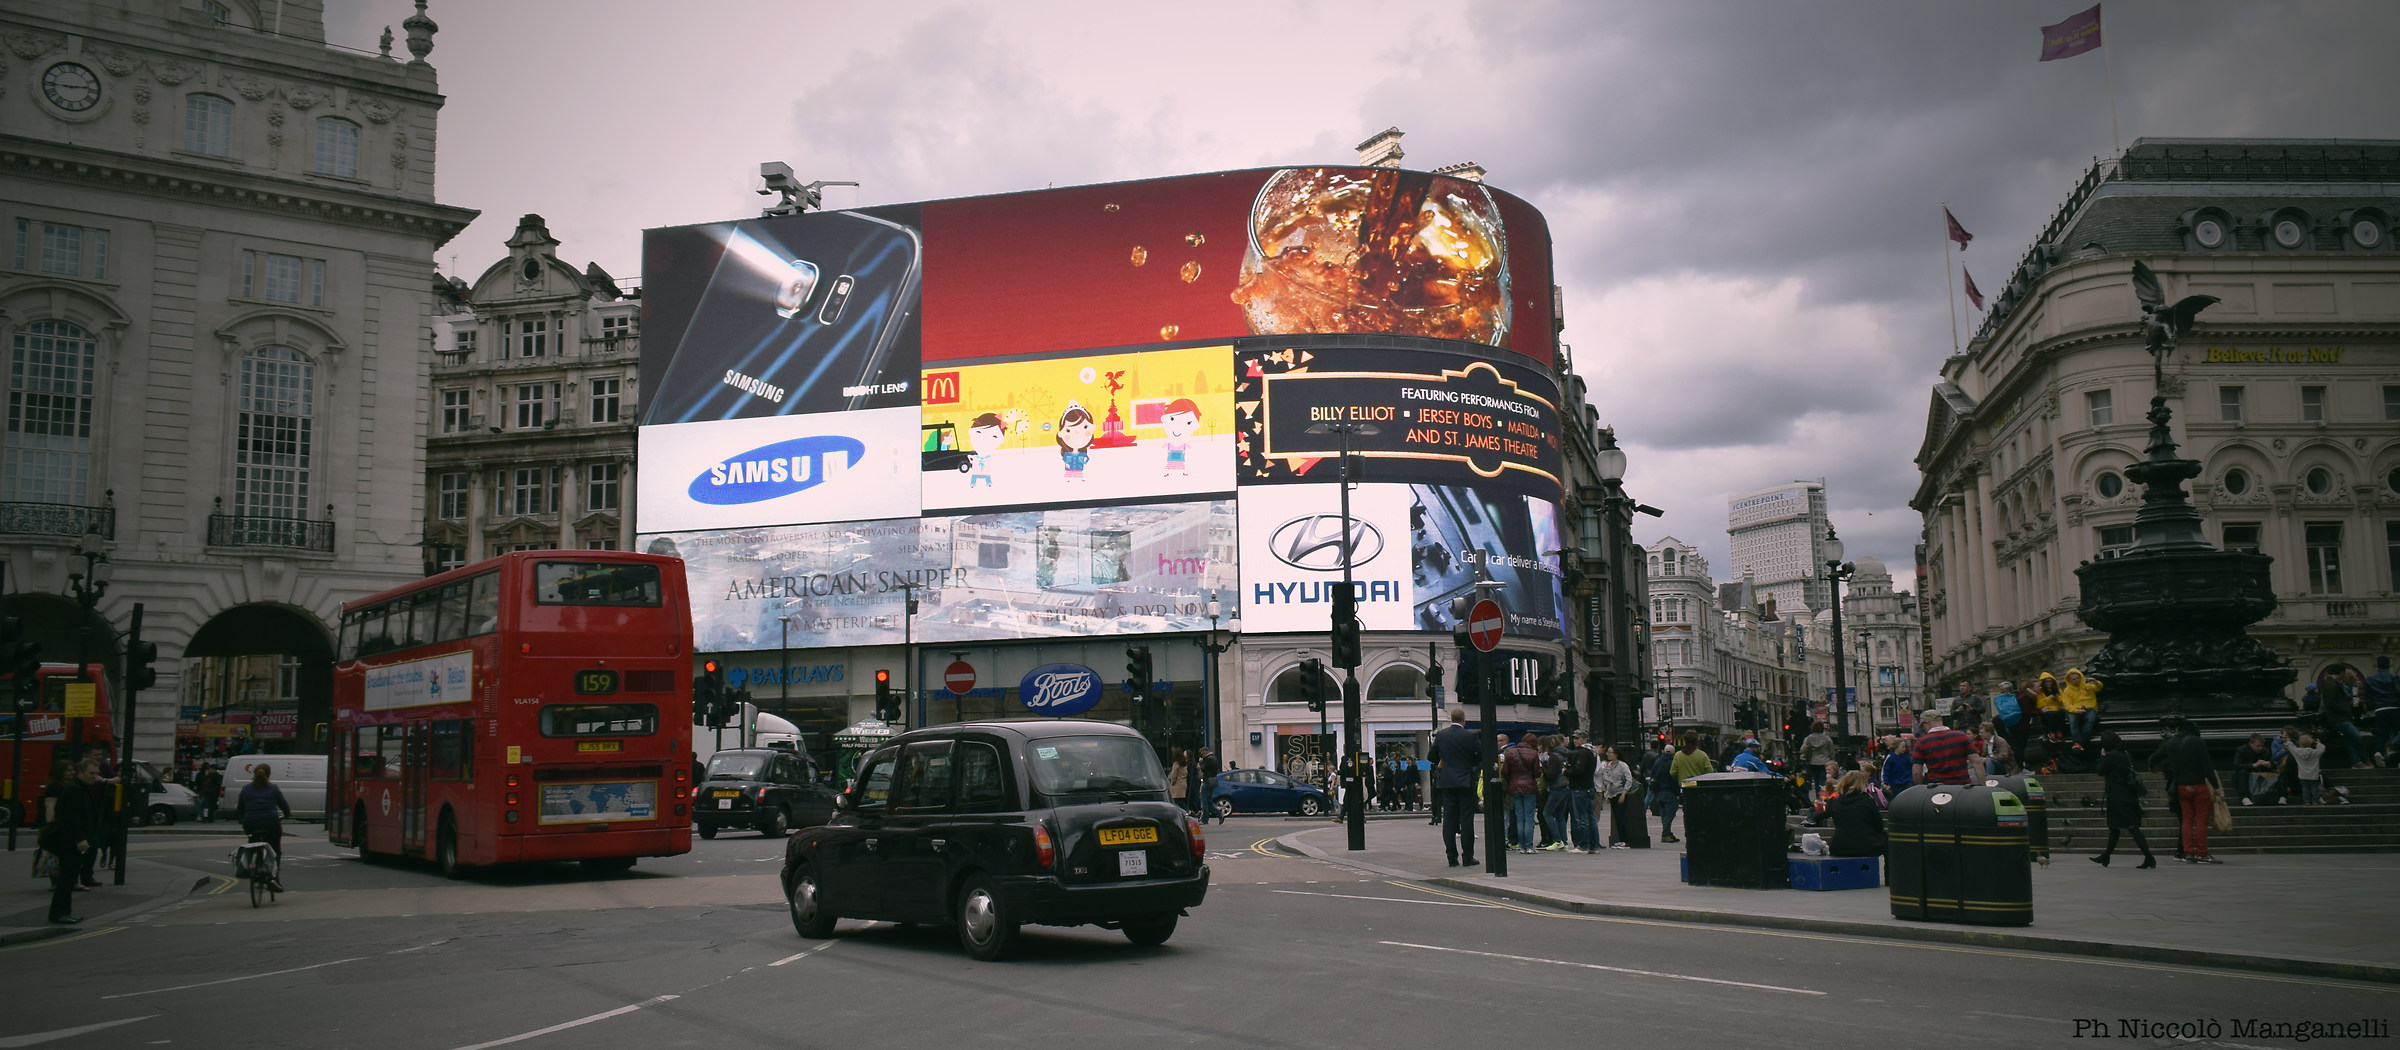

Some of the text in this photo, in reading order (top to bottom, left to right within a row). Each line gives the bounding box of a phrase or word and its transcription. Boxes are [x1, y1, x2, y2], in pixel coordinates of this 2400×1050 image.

[2207, 345, 2344, 362] Believe It or Not!
[724, 369, 784, 403] SAMSUNG
[843, 381, 908, 397] BHT LENS
[1401, 388, 1540, 419] FEATURING PERFORMANCES FROM
[1310, 406, 1541, 440] BILLY ELLIOT JERSEY BOYS MATILDA
[1406, 428, 1440, 444] AND
[1444, 431, 1461, 446] ST.
[1464, 432, 1501, 451] JAMES
[1503, 438, 1538, 459] THEATRE
[1735, 493, 1784, 511] CENTRE POINT
[696, 538, 713, 547] THE
[715, 537, 739, 546] MOST
[742, 532, 818, 544] CONTROVERSIAL
[821, 530, 841, 540] AND
[957, 521, 976, 531] THE
[978, 520, 1002, 530] YEAR
[770, 550, 809, 561] COOPER
[898, 543, 934, 554] SIENNA
[1158, 553, 1208, 575] hmv
[1491, 554, 1506, 566] car
[1507, 555, 1532, 569] deliver
[1533, 560, 1538, 570] a
[724, 566, 975, 601] AMERICAN SNIPER
[1254, 580, 1400, 605] HYUNDAI
[832, 596, 885, 607] INCREDIBLE
[1016, 610, 1039, 623] ON
[1117, 605, 1128, 618] &
[1133, 603, 1167, 617] DVD
[1510, 613, 1520, 626] My
[1522, 616, 1537, 625] name
[1537, 616, 1543, 626] is
[1796, 631, 1805, 660] LYRIC
[583, 674, 611, 692] 159
[1121, 678, 1174, 694] buty
[1511, 657, 1539, 696] GAP
[933, 686, 1006, 702] phamacy
[1027, 672, 1092, 708] Boots
[29, 714, 61, 734] fitflop
[602, 742, 617, 750] BRX
[1104, 828, 1153, 842] LF04 GGE
